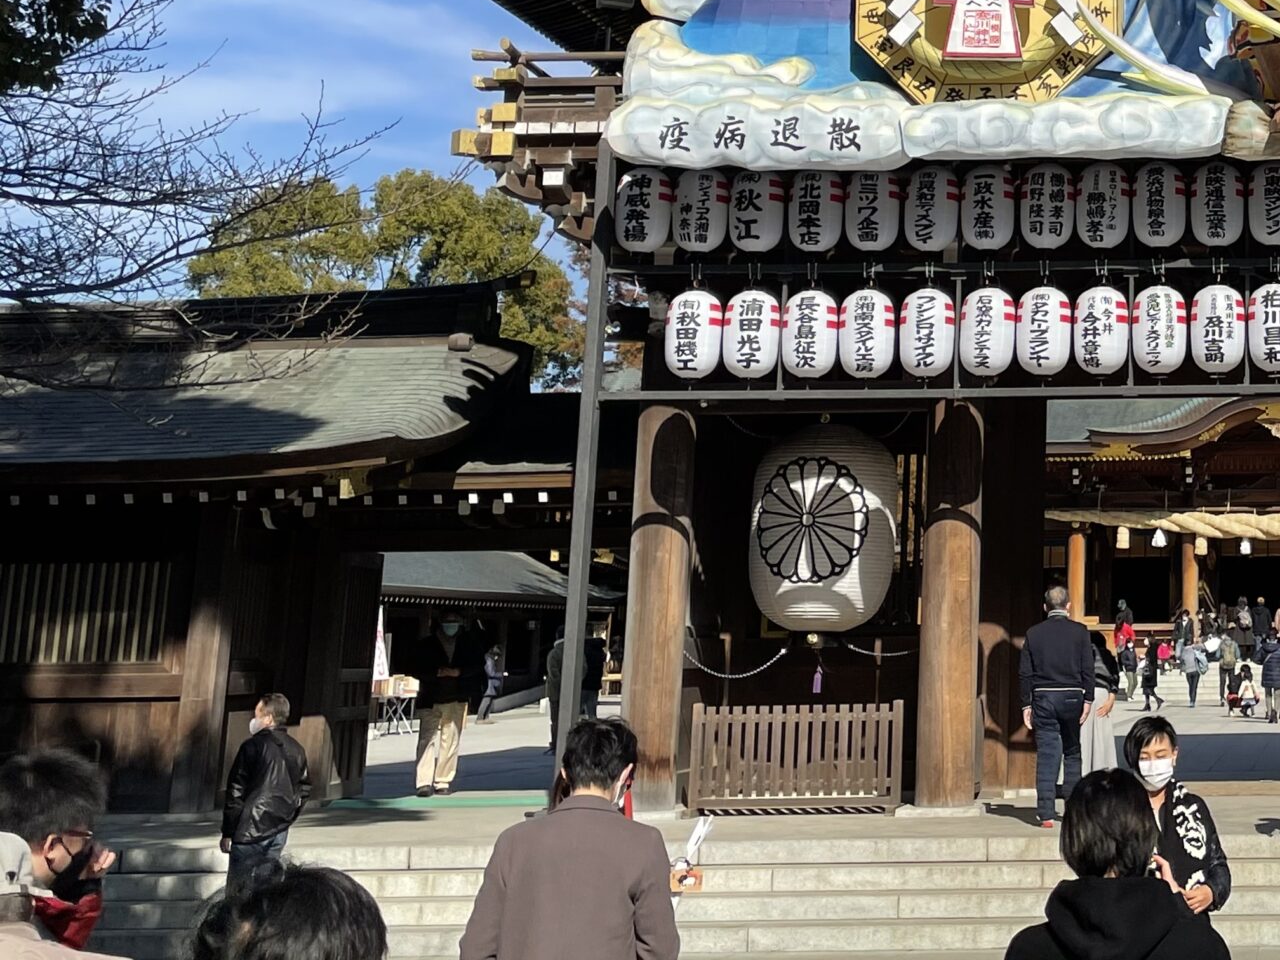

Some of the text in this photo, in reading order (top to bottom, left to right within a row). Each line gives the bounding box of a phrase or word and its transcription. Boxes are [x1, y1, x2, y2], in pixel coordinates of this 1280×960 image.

[658, 114, 862, 153] 疫病退散
[674, 298, 701, 372] (有)秋田機工
